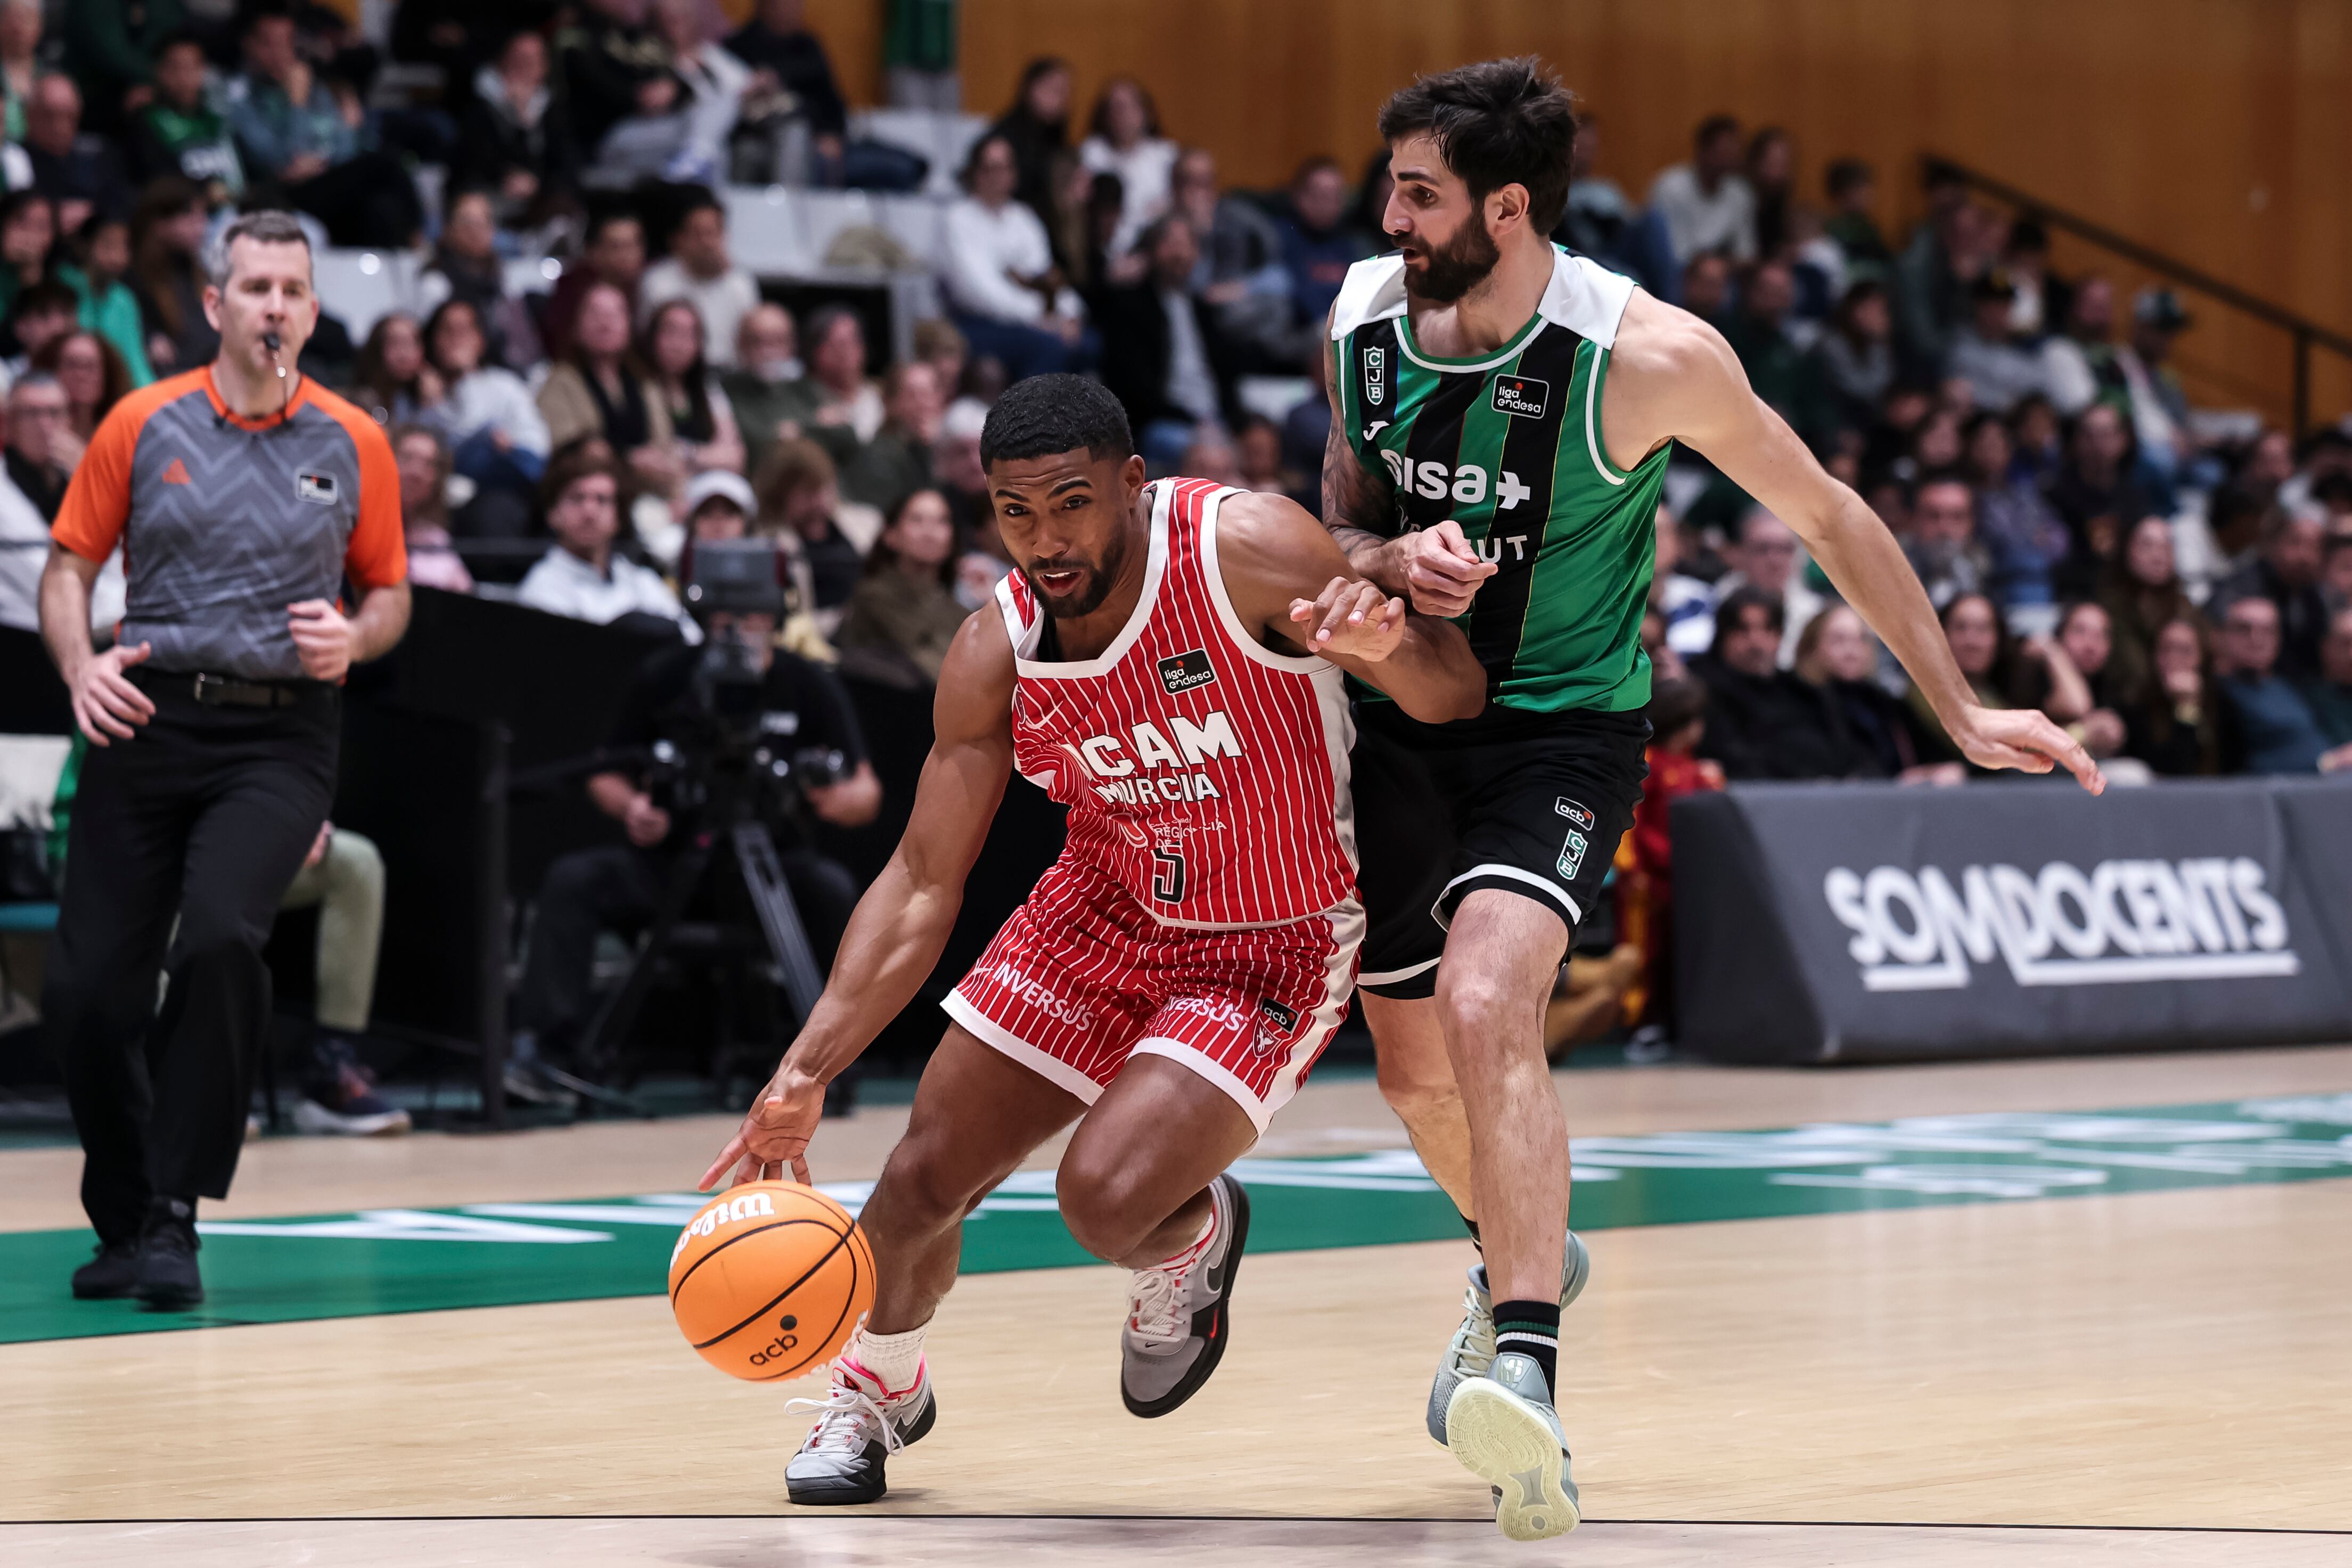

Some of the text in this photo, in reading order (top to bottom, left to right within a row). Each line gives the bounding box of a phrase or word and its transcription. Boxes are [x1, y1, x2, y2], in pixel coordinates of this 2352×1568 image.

[1498, 385, 1520, 399] liga
[1497, 398, 1541, 414] endesa
[1164, 668, 1185, 680] liga
[1169, 670, 1212, 689] endesa
[1062, 711, 1243, 781] CAM
[1095, 773, 1222, 805] MURCIA
[1560, 804, 1585, 822] acb
[992, 960, 1094, 1031] INVERSUS
[1264, 1007, 1288, 1025] acb
[749, 1334, 799, 1366] acb
